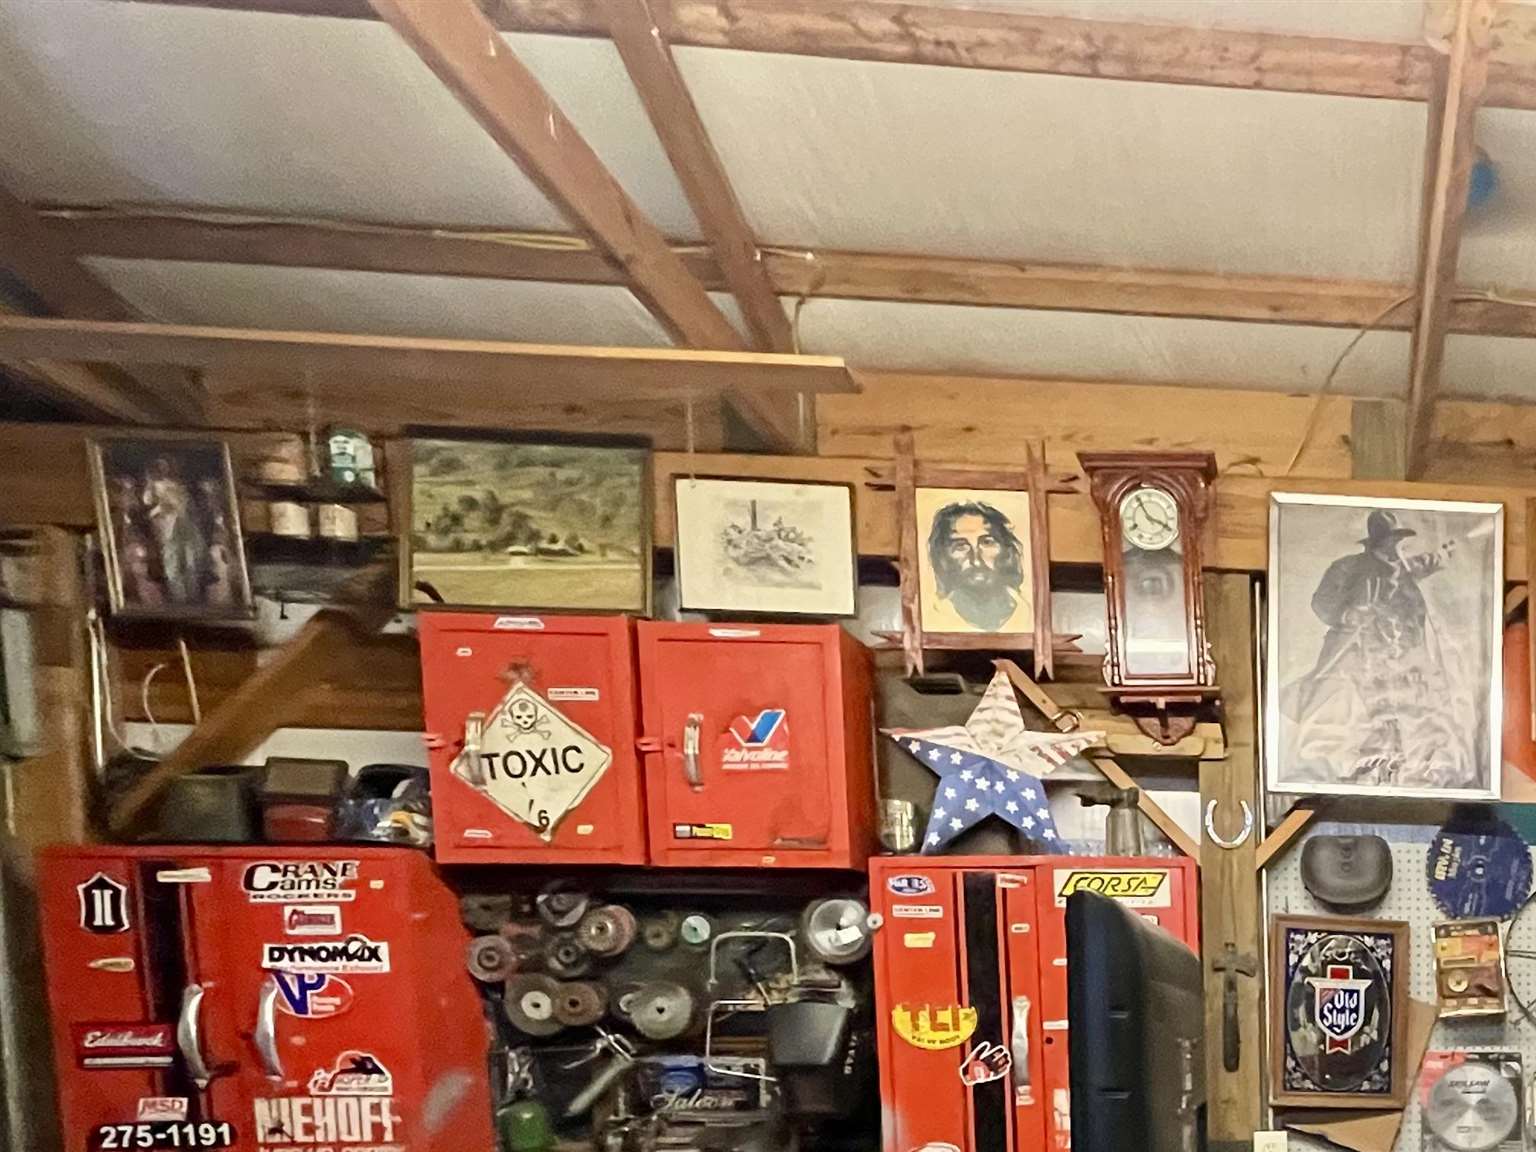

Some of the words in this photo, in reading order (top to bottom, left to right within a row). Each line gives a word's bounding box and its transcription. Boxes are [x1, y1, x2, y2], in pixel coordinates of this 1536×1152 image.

[481, 745, 584, 780] TOXIC
[537, 810, 550, 828] 6
[1073, 876, 1157, 893] CORSA
[268, 938, 383, 963] DYNOMAX
[273, 971, 326, 1015] VP
[1334, 989, 1358, 1010] Old
[1322, 1001, 1358, 1034] Style
[99, 1122, 231, 1149] 275-1191
